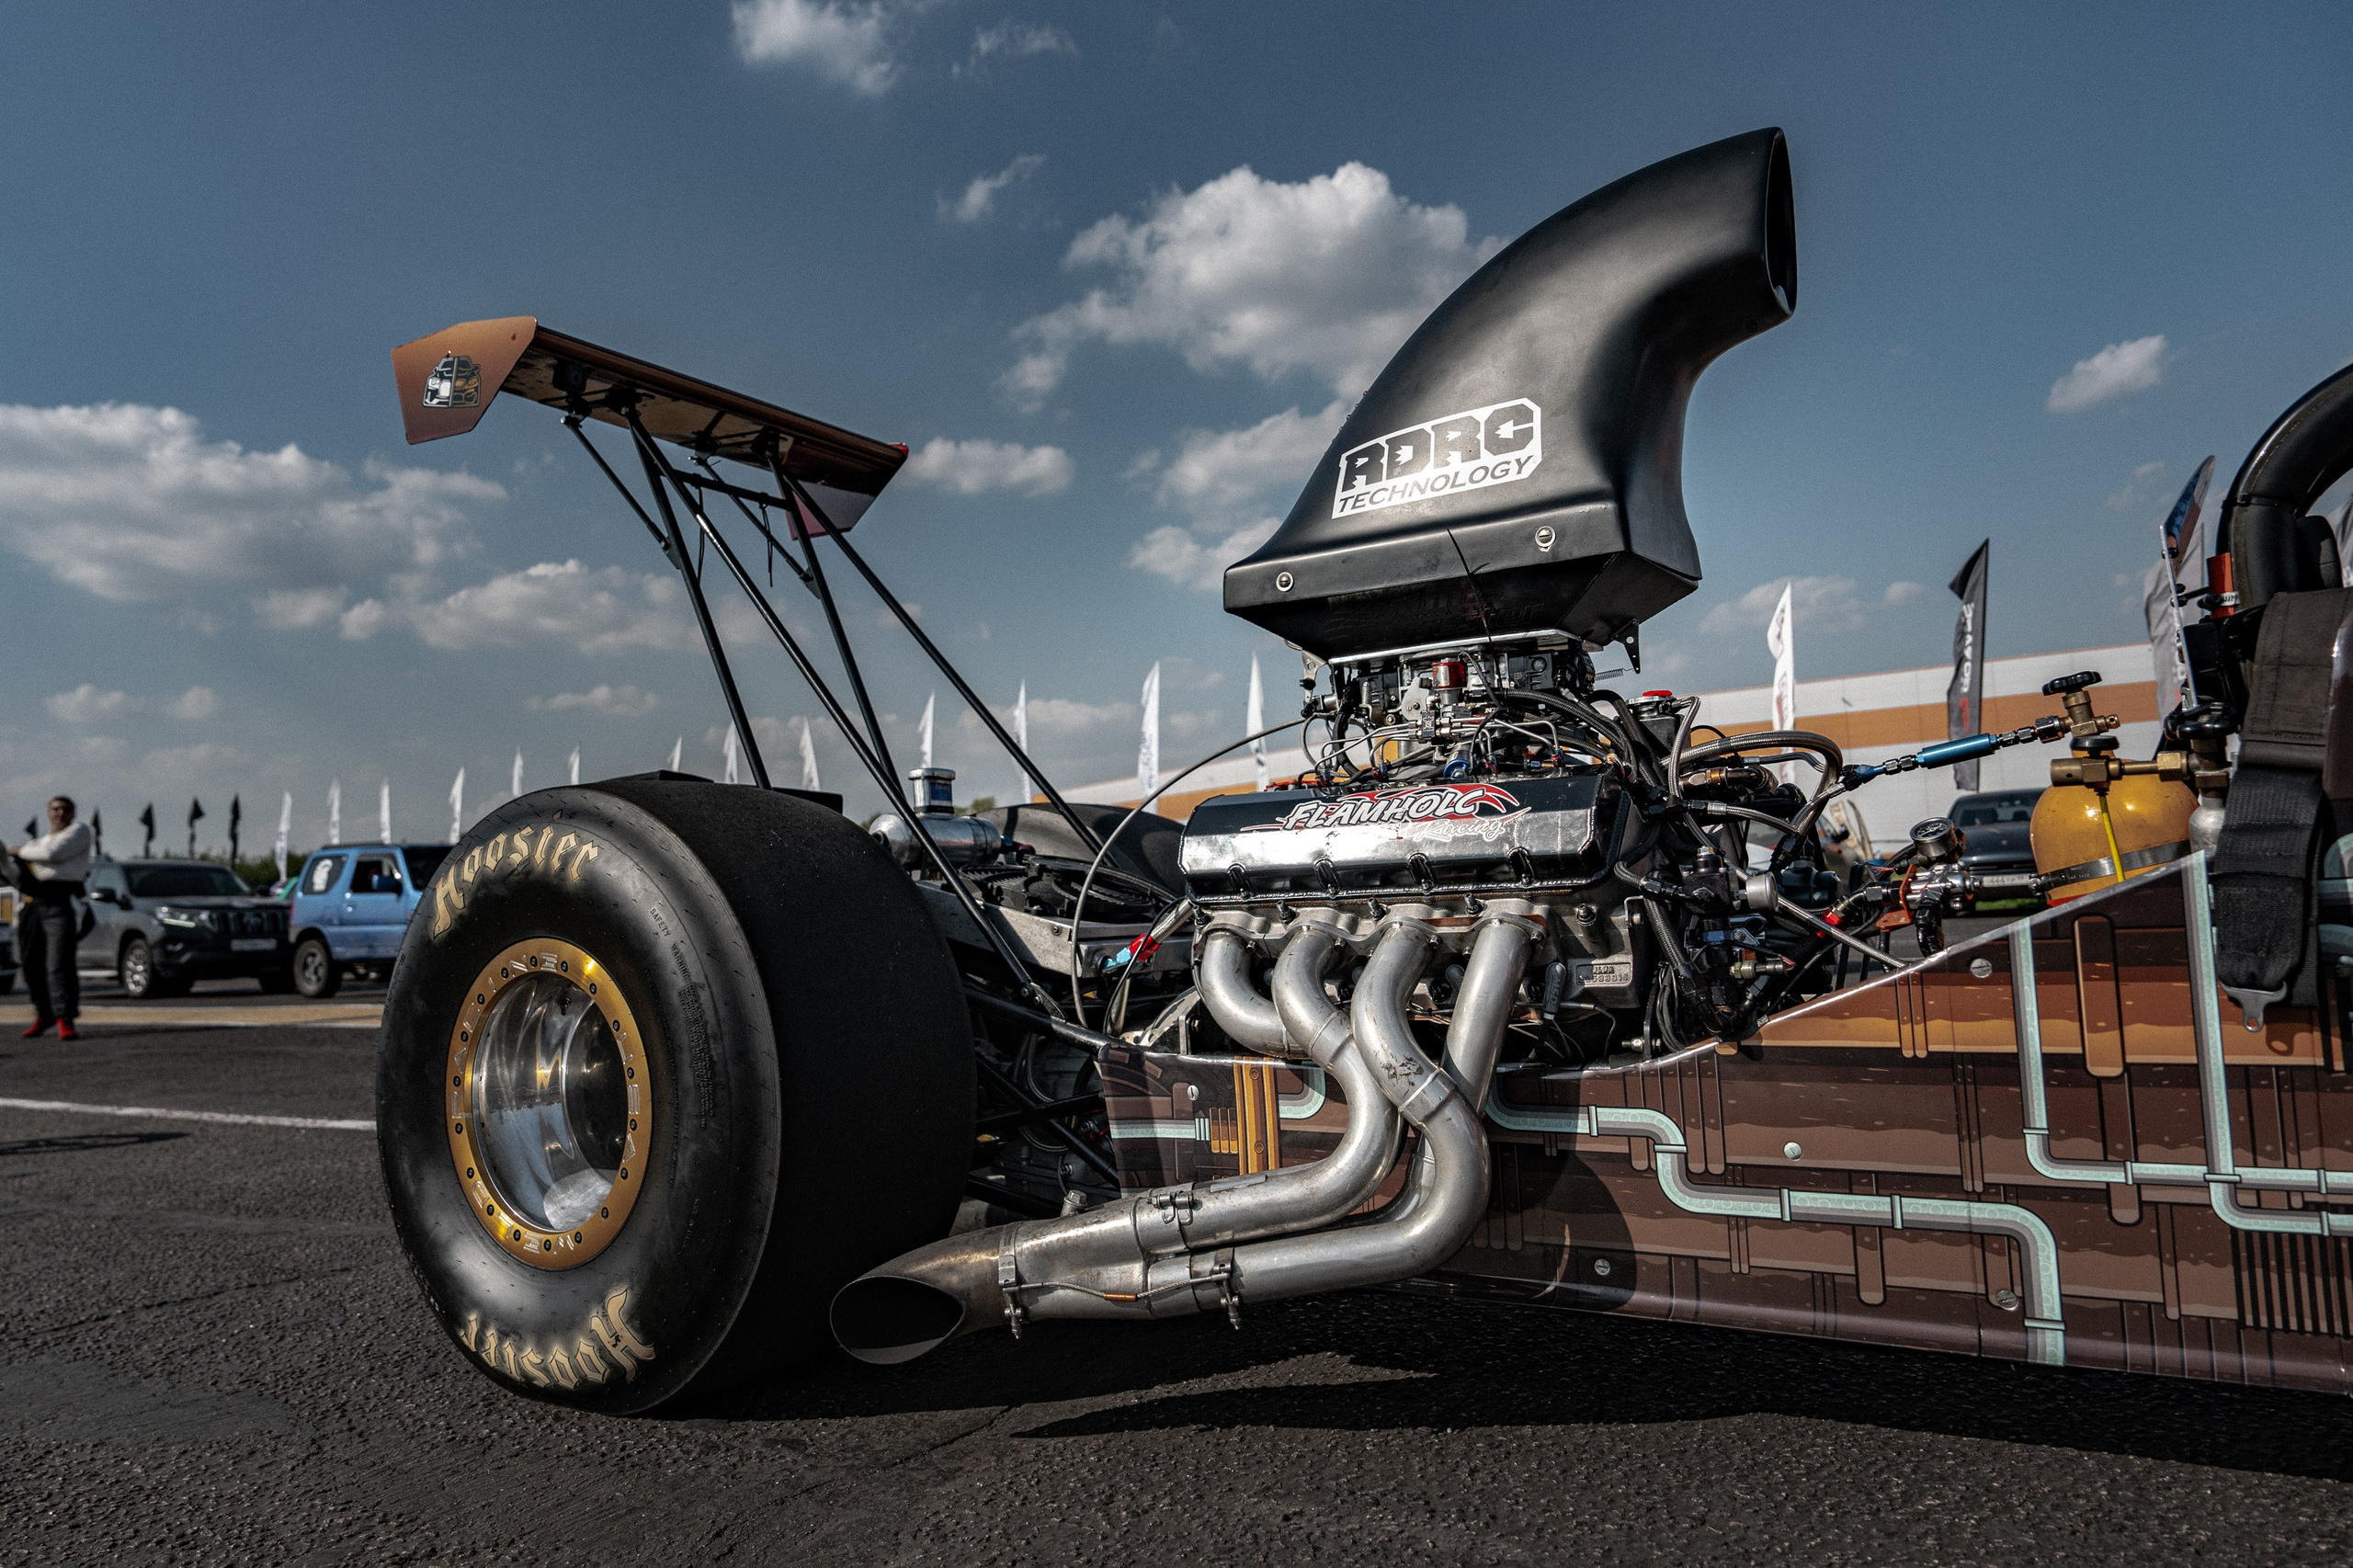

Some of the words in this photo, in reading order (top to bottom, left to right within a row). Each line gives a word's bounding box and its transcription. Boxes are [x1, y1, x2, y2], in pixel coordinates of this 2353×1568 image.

[1338, 454, 1534, 514] TECHNOLOGY
[1284, 788, 1486, 831] FLAMHOLC
[1413, 817, 1506, 842] Racing
[650, 908, 671, 937] SAFETY
[671, 943, 690, 982] WARNING
